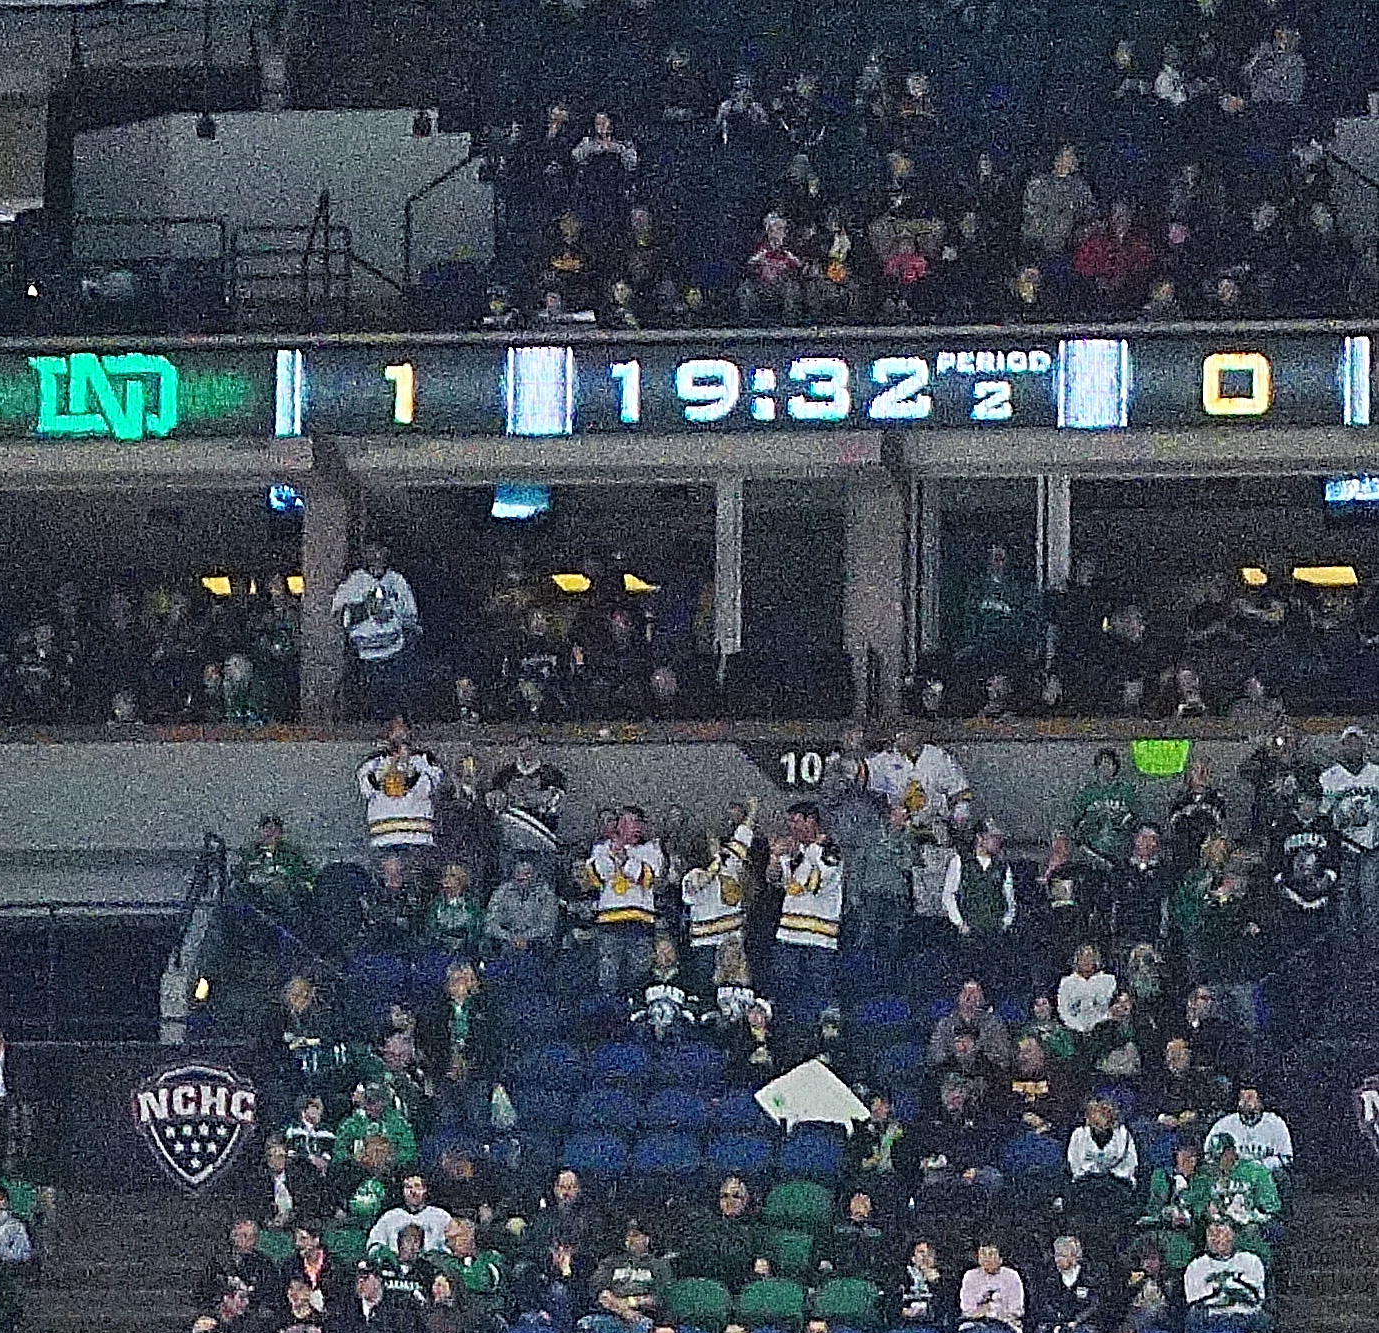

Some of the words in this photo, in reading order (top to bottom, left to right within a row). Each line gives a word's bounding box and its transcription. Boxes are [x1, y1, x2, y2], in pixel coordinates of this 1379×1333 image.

[937, 350, 1052, 376] PERIOD
[384, 362, 414, 425] 1
[610, 354, 932, 423] 19:32
[972, 381, 1014, 421] 2
[1203, 352, 1273, 416] 0
[780, 751, 841, 784] 10
[137, 1085, 256, 1122] NCHC
